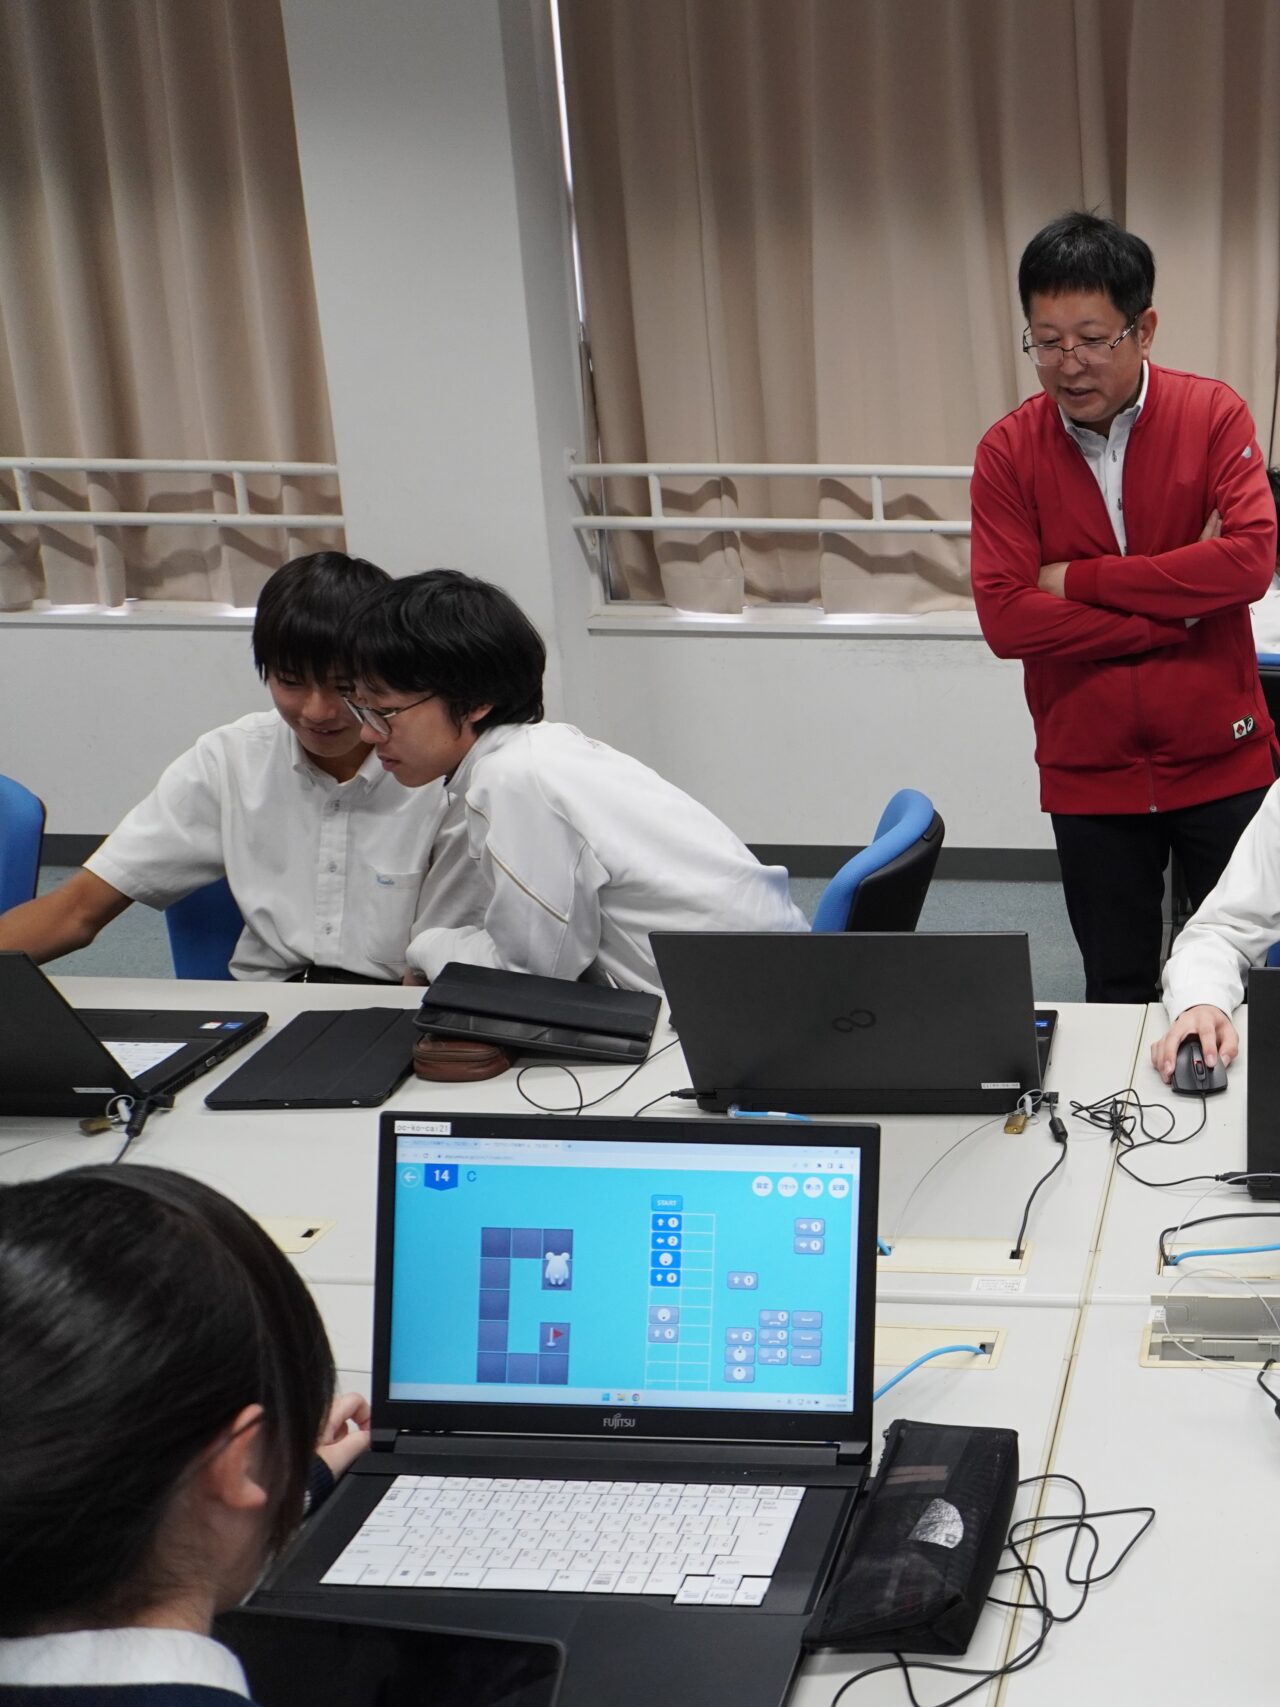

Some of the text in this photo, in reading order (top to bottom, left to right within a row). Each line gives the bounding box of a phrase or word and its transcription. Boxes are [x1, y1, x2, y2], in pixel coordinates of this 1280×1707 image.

[433, 1169, 477, 1183] 14 C
[602, 1412, 636, 1430] FUJITSU
